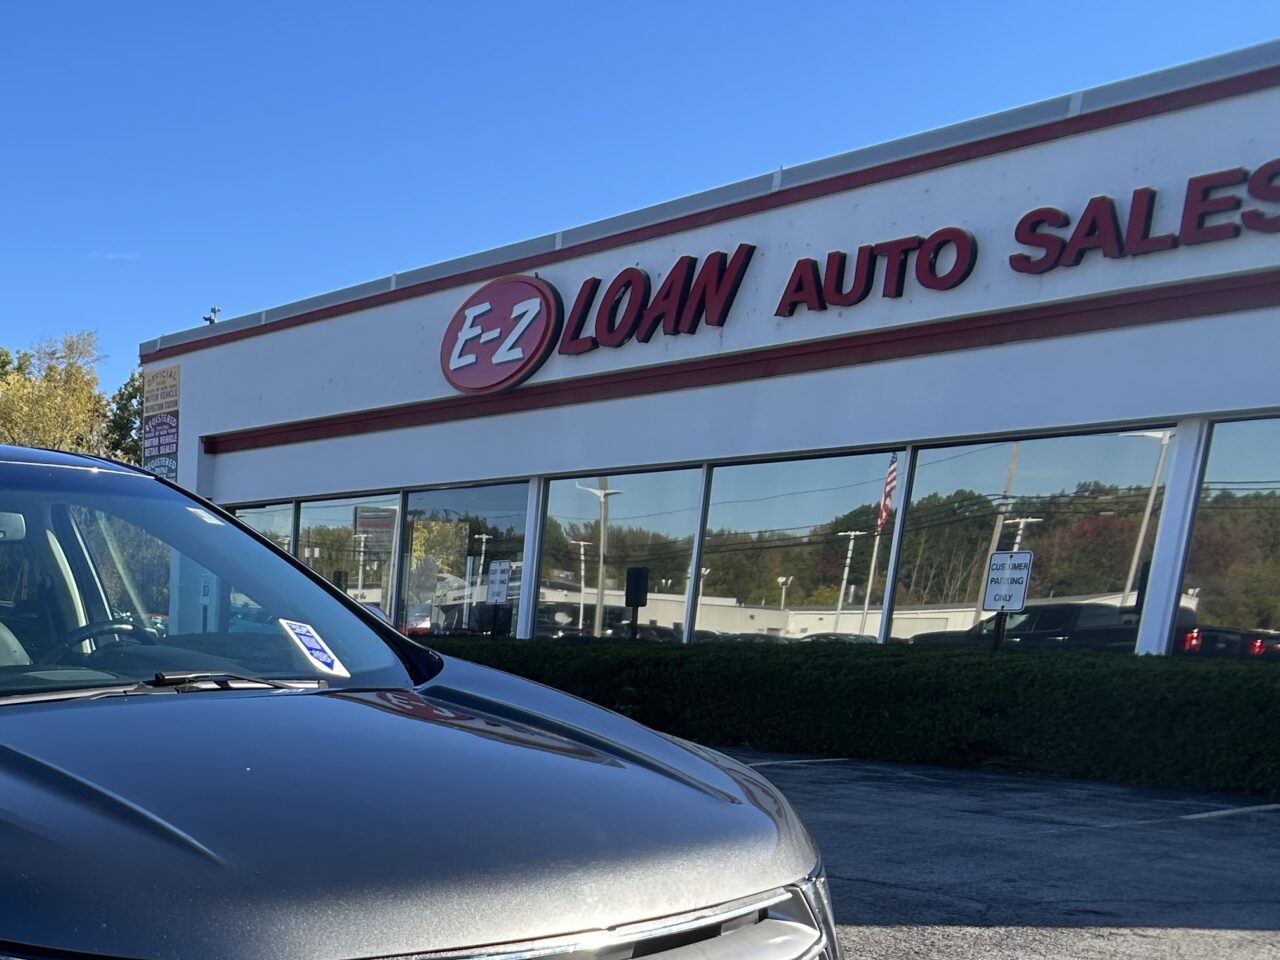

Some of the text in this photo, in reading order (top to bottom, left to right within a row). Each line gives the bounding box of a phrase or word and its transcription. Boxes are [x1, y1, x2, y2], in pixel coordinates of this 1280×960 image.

[449, 156, 1280, 371] E-Z LOAN AUTO SALES
[148, 370, 177, 386] OFFICIAL
[145, 413, 177, 431] REGISTERED
[160, 433, 177, 444] VEHICLE
[145, 443, 176, 457] RETAIL DEALER
[991, 563, 1028, 571] CUSOMER
[993, 594, 1013, 602] ONLY
